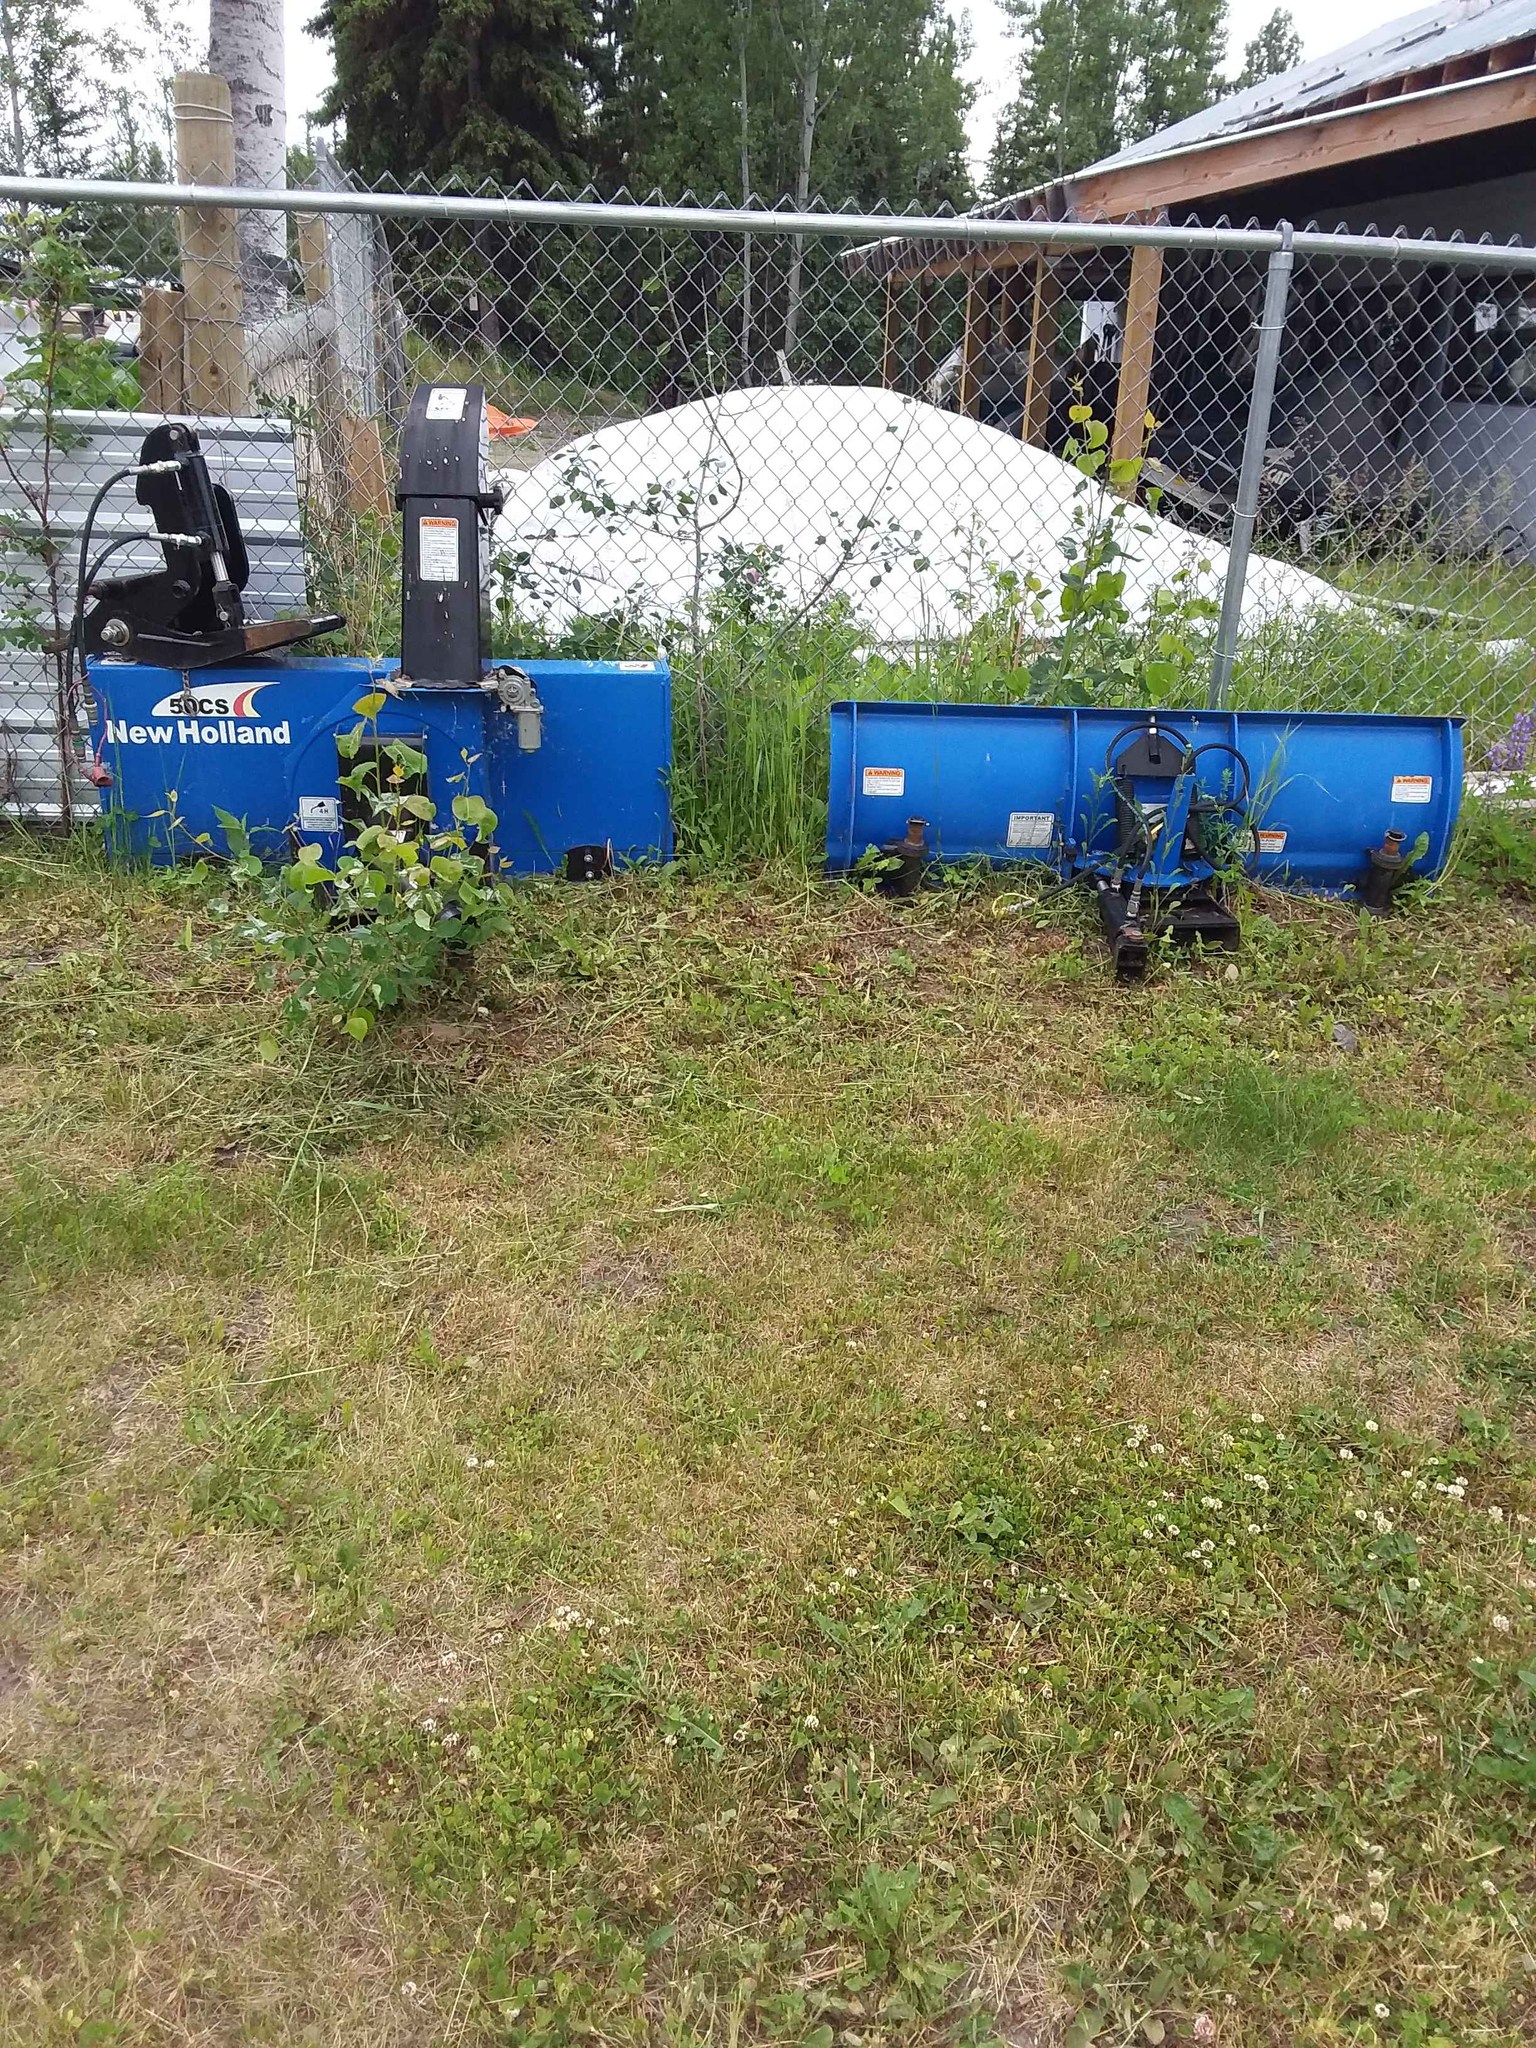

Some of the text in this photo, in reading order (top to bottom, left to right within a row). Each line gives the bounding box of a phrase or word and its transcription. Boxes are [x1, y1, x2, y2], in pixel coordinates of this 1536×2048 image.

[169, 698, 229, 715] 50CS
[105, 719, 291, 744] New Holland
